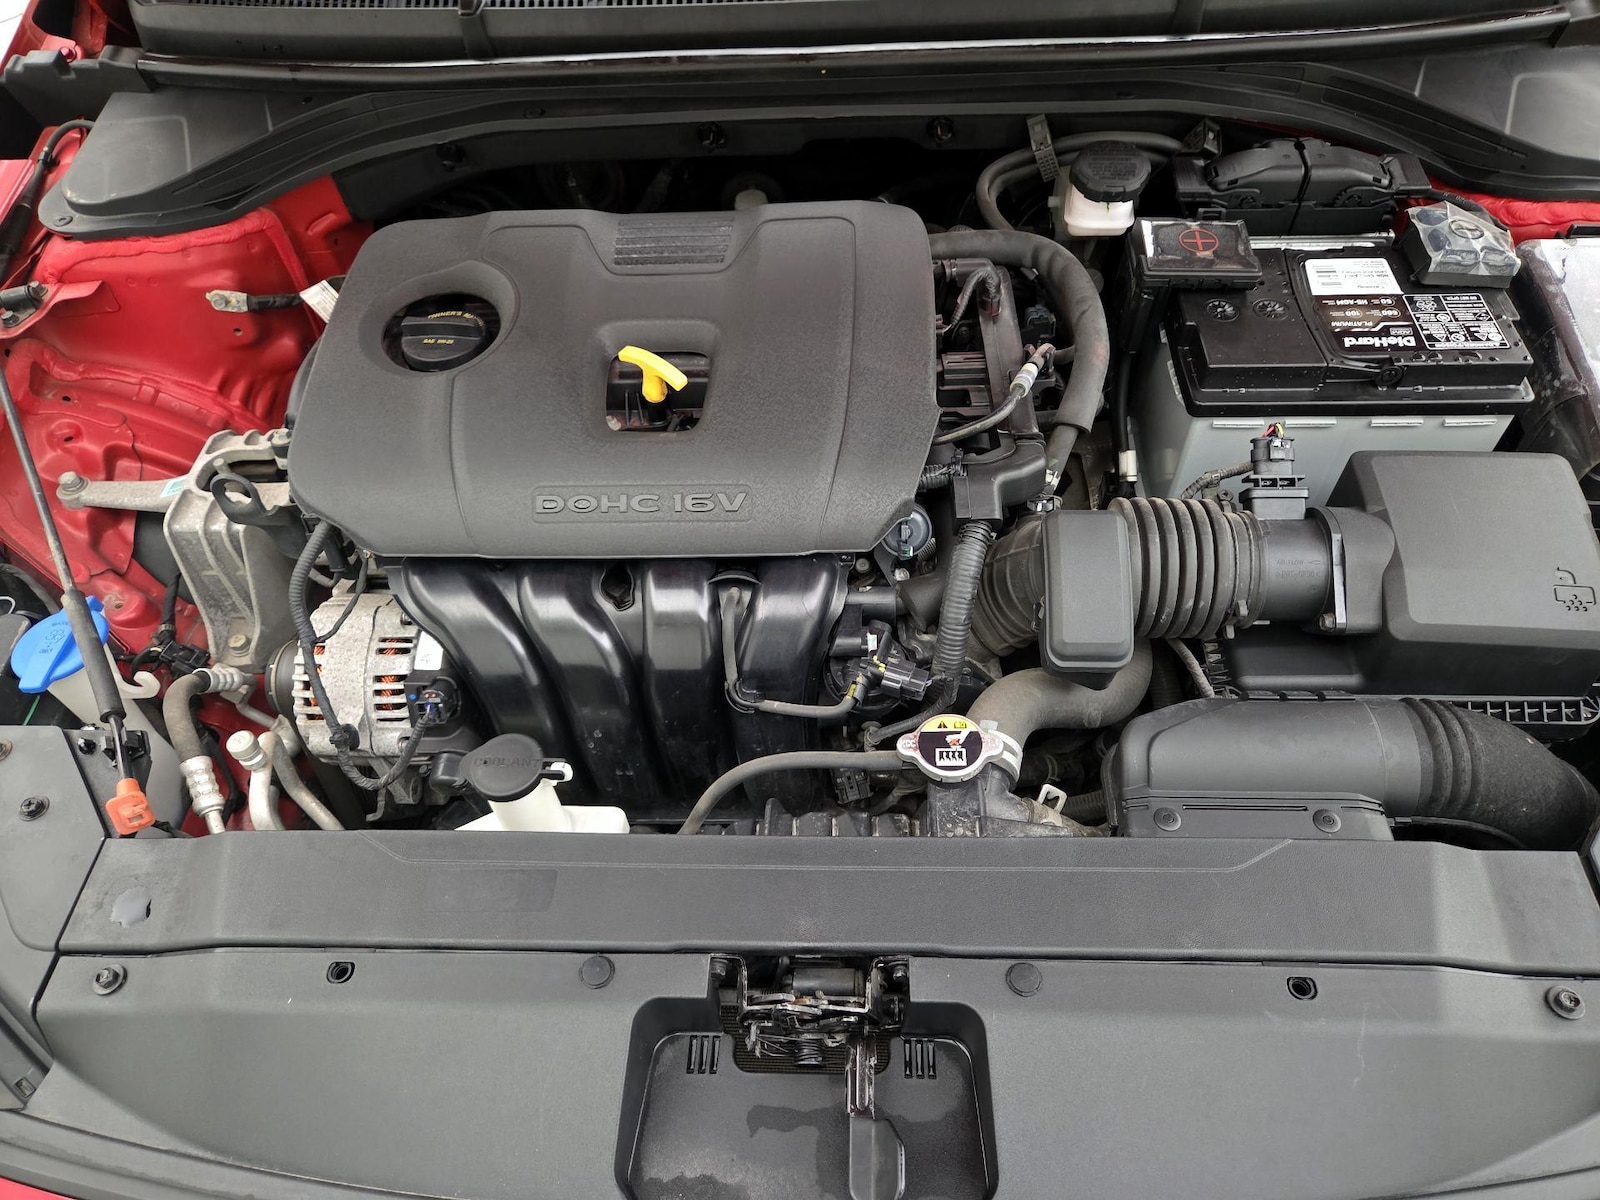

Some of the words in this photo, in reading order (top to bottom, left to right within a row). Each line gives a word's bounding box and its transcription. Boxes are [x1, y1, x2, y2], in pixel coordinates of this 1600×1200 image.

[1343, 336, 1416, 348] DieHard
[535, 494, 661, 514] DOHC
[672, 492, 748, 513] 16V
[473, 757, 542, 769] COOLANT
